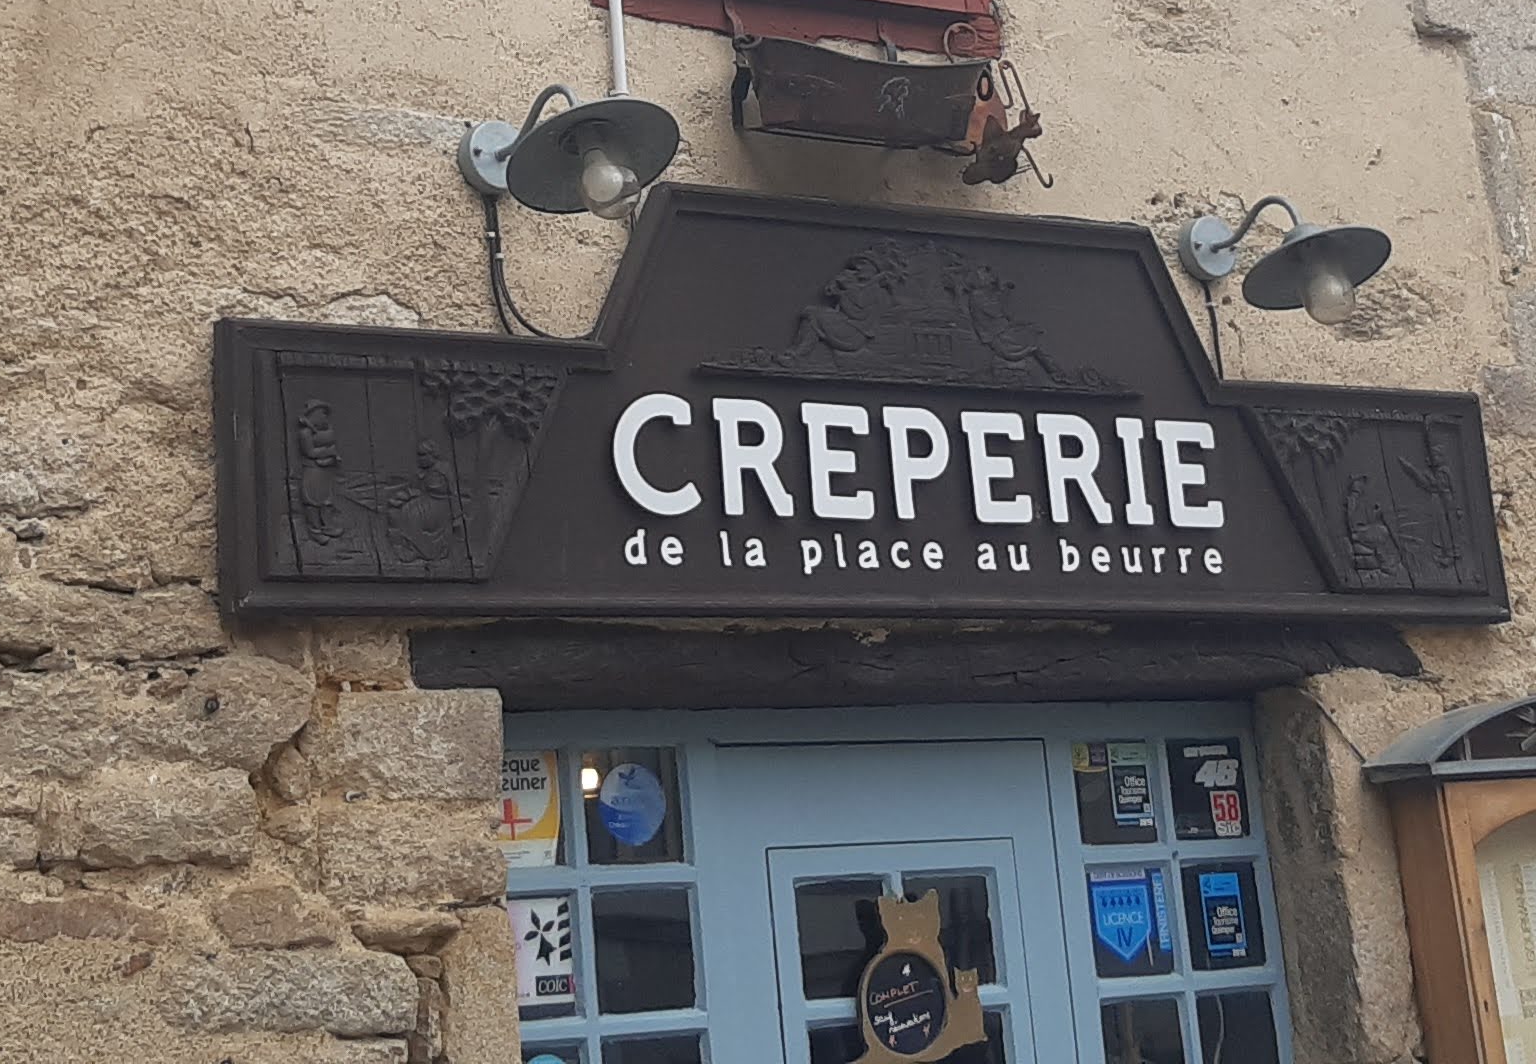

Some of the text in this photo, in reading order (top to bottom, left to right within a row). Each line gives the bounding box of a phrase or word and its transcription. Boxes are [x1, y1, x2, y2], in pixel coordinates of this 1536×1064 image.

[613, 393, 1224, 527] CREPERIE
[624, 530, 1225, 574] de la place au beurre
[1212, 793, 1239, 822] 58
[1102, 911, 1144, 926] LICENCE
[1116, 927, 1133, 948] IV
